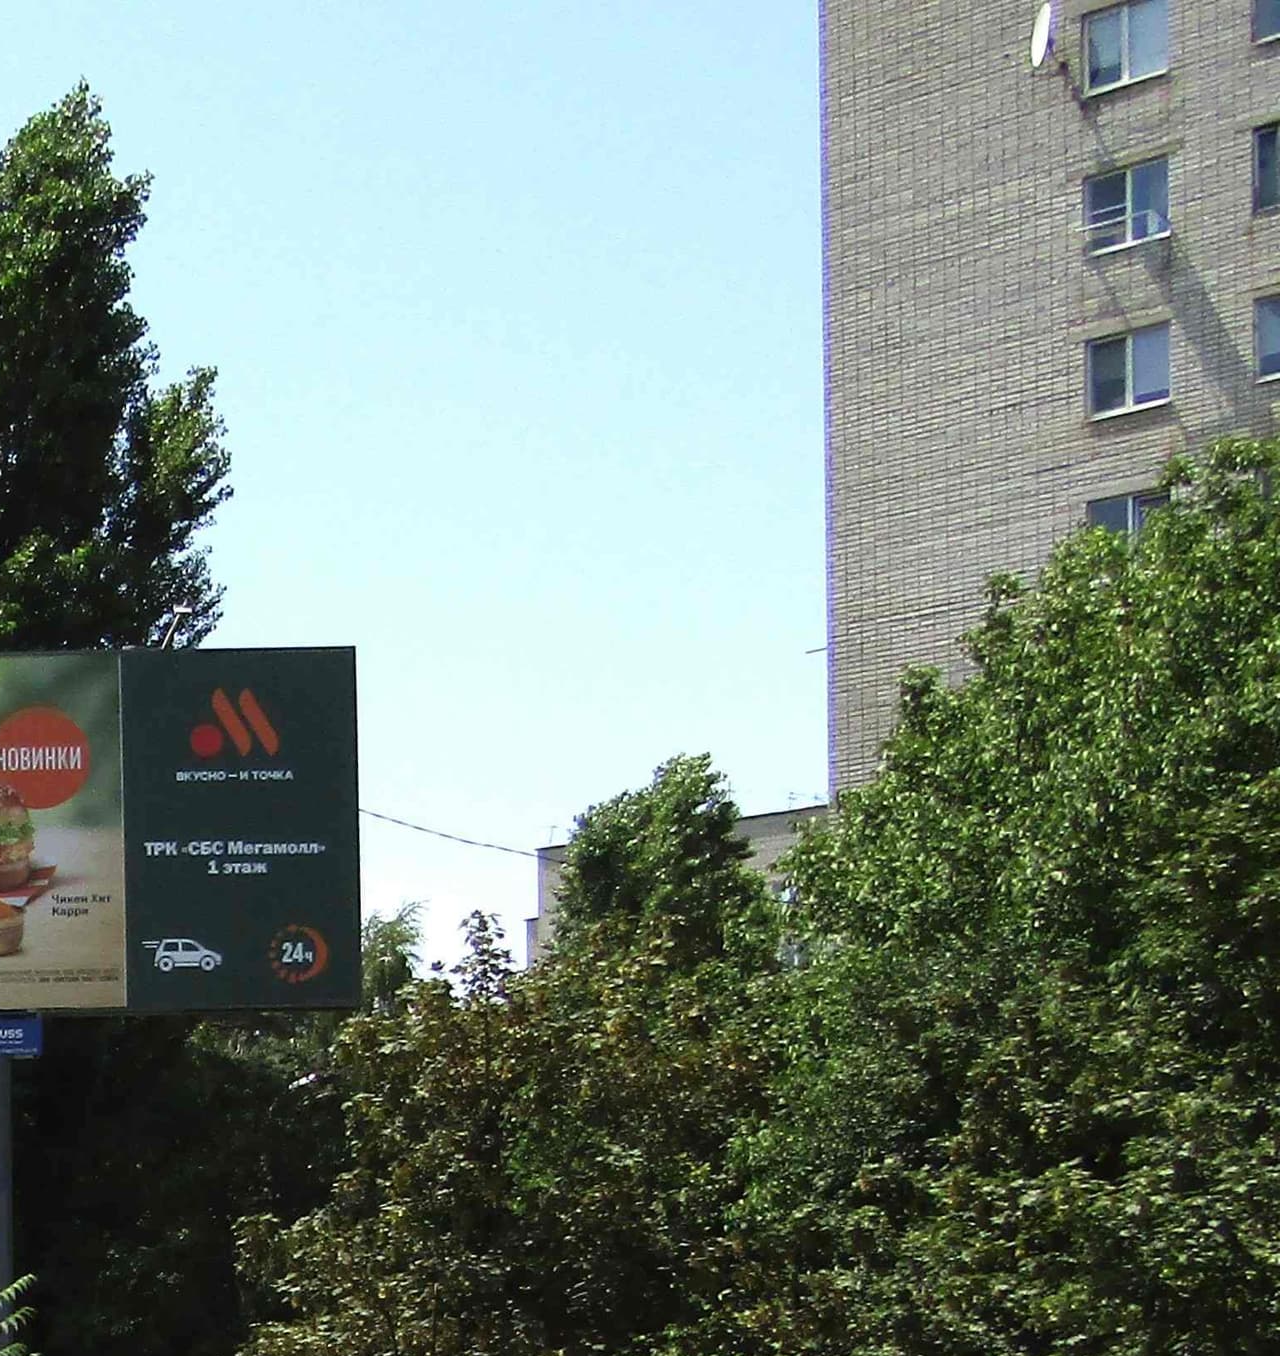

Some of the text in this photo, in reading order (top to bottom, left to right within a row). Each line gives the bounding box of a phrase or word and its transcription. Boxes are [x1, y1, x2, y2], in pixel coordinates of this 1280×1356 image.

[176, 771, 226, 782] ВКУСНО
[239, 771, 249, 781] И
[251, 770, 294, 781] ТОЧКА
[144, 842, 178, 856] ТРК
[207, 860, 268, 874] 1 этаж
[51, 894, 89, 905] Чикен
[51, 906, 90, 917] Карри
